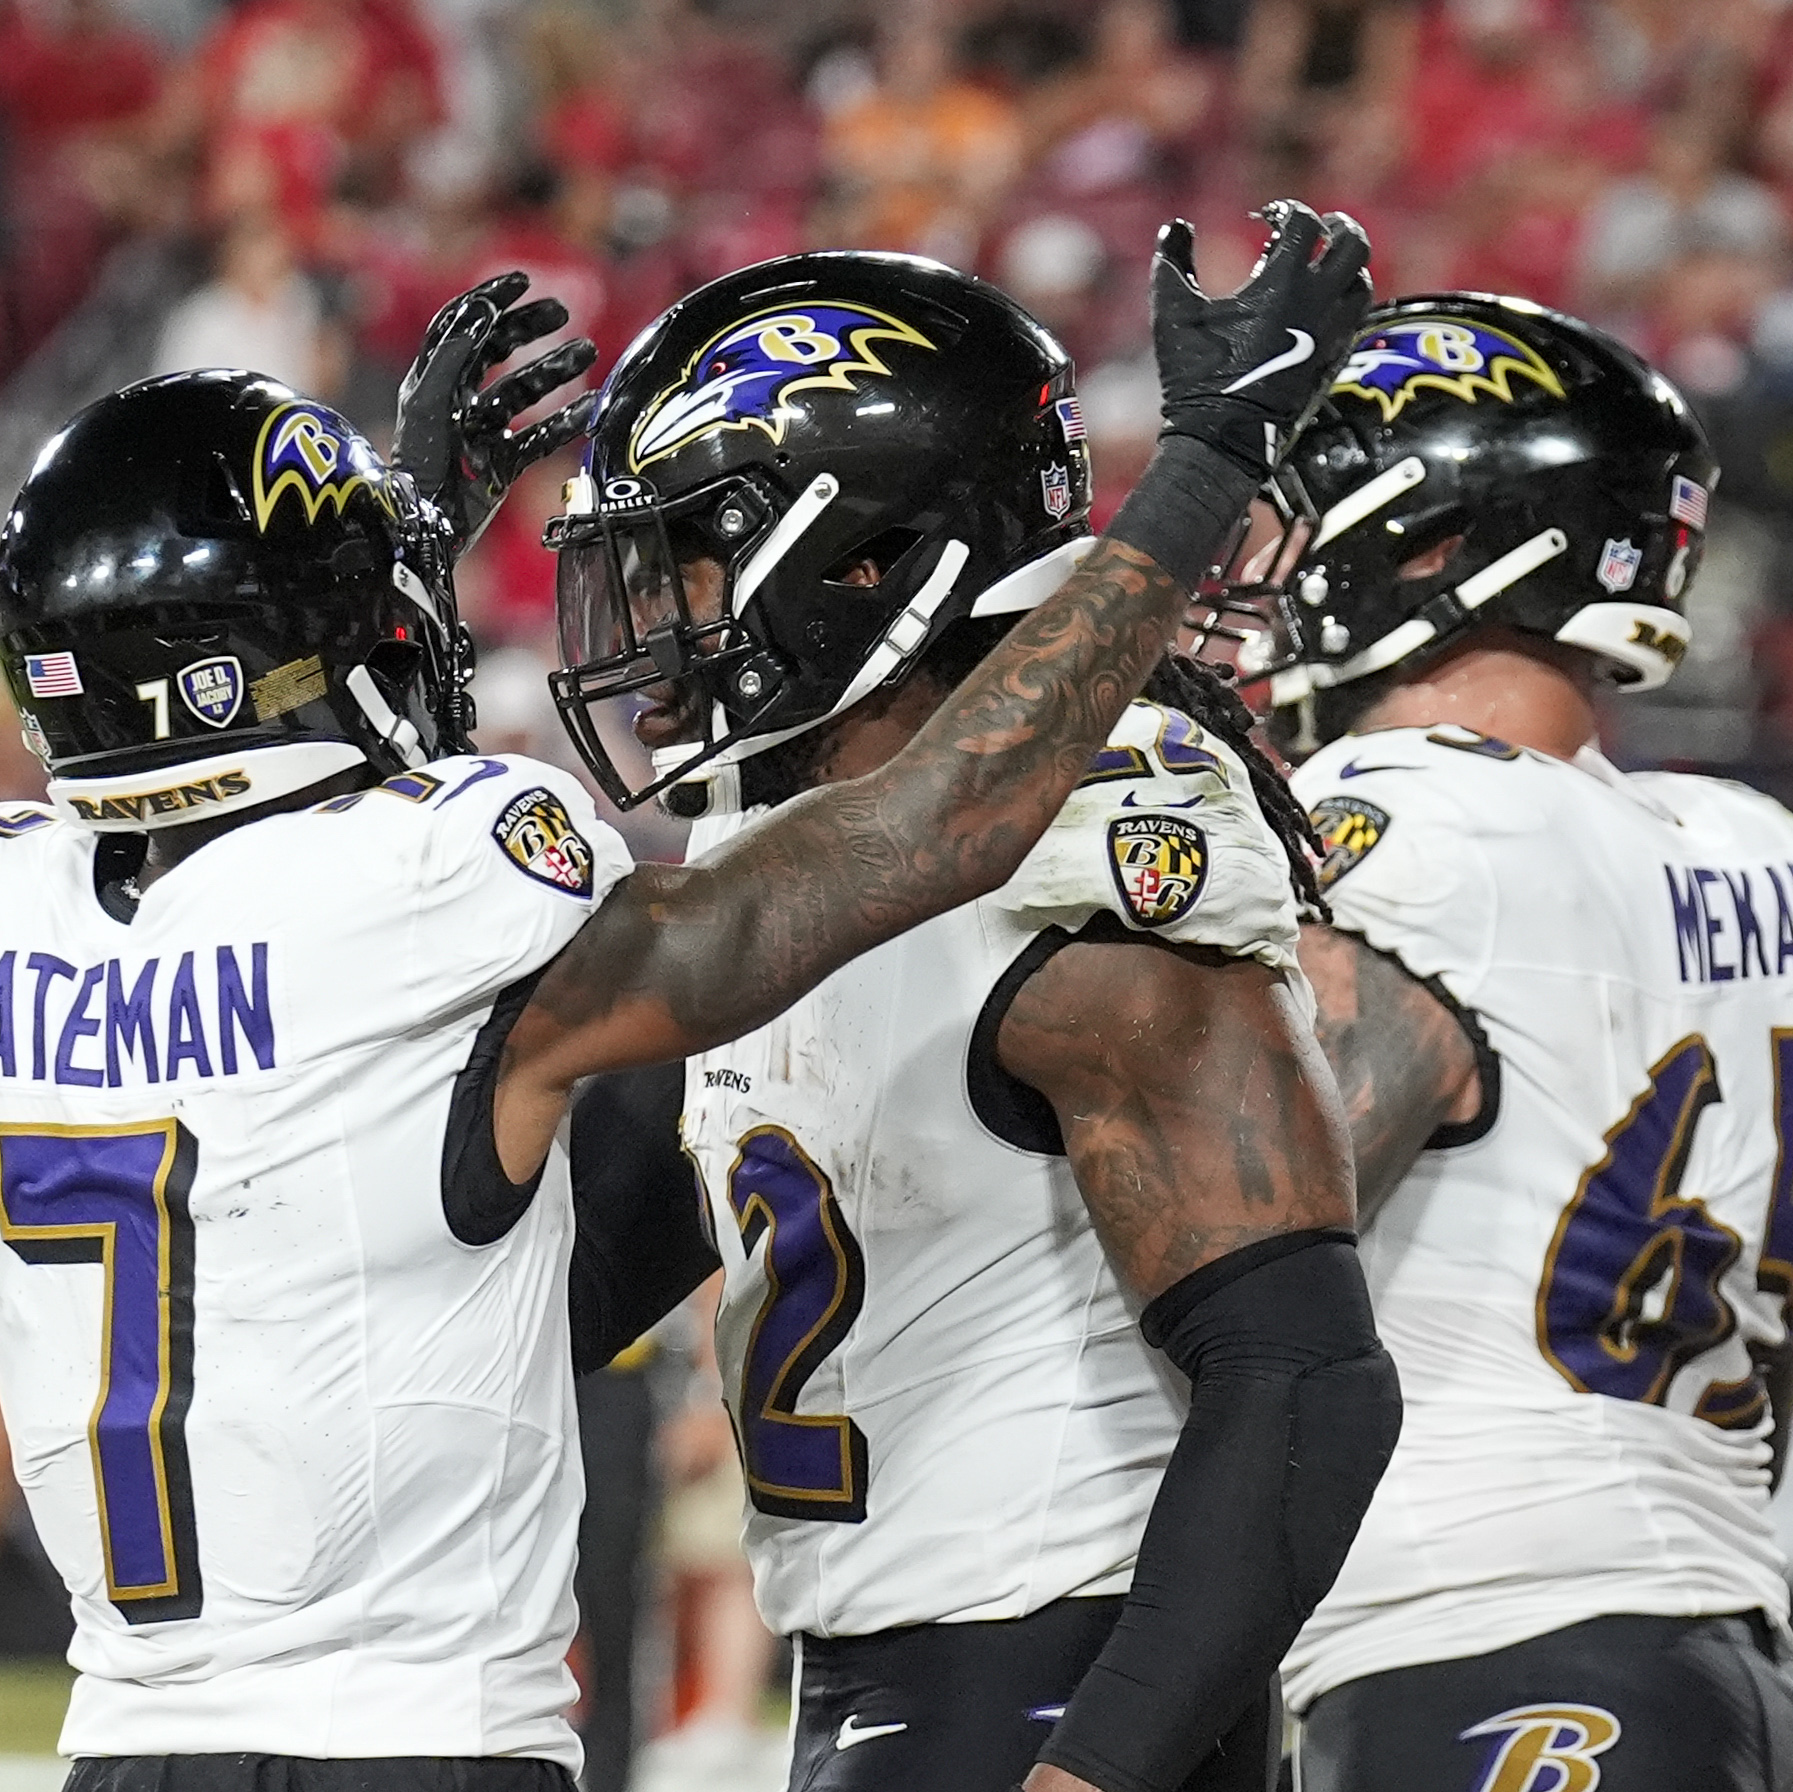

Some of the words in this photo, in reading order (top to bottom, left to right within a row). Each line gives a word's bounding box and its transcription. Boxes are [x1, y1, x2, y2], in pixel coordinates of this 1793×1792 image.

[723, 314, 841, 365] B
[272, 412, 340, 485] B
[600, 494, 655, 513] OAKLEY
[190, 671, 215, 692] JOE
[216, 665, 231, 686] D.
[135, 677, 170, 740] 7
[68, 768, 252, 822] RAVENS
[496, 789, 549, 840] RAVENS
[513, 819, 546, 863] B
[1116, 835, 1162, 866] B
[1117, 819, 1198, 842] RAVENS
[704, 1068, 752, 1094] RVENS
[680, 1115, 868, 1524] 2
